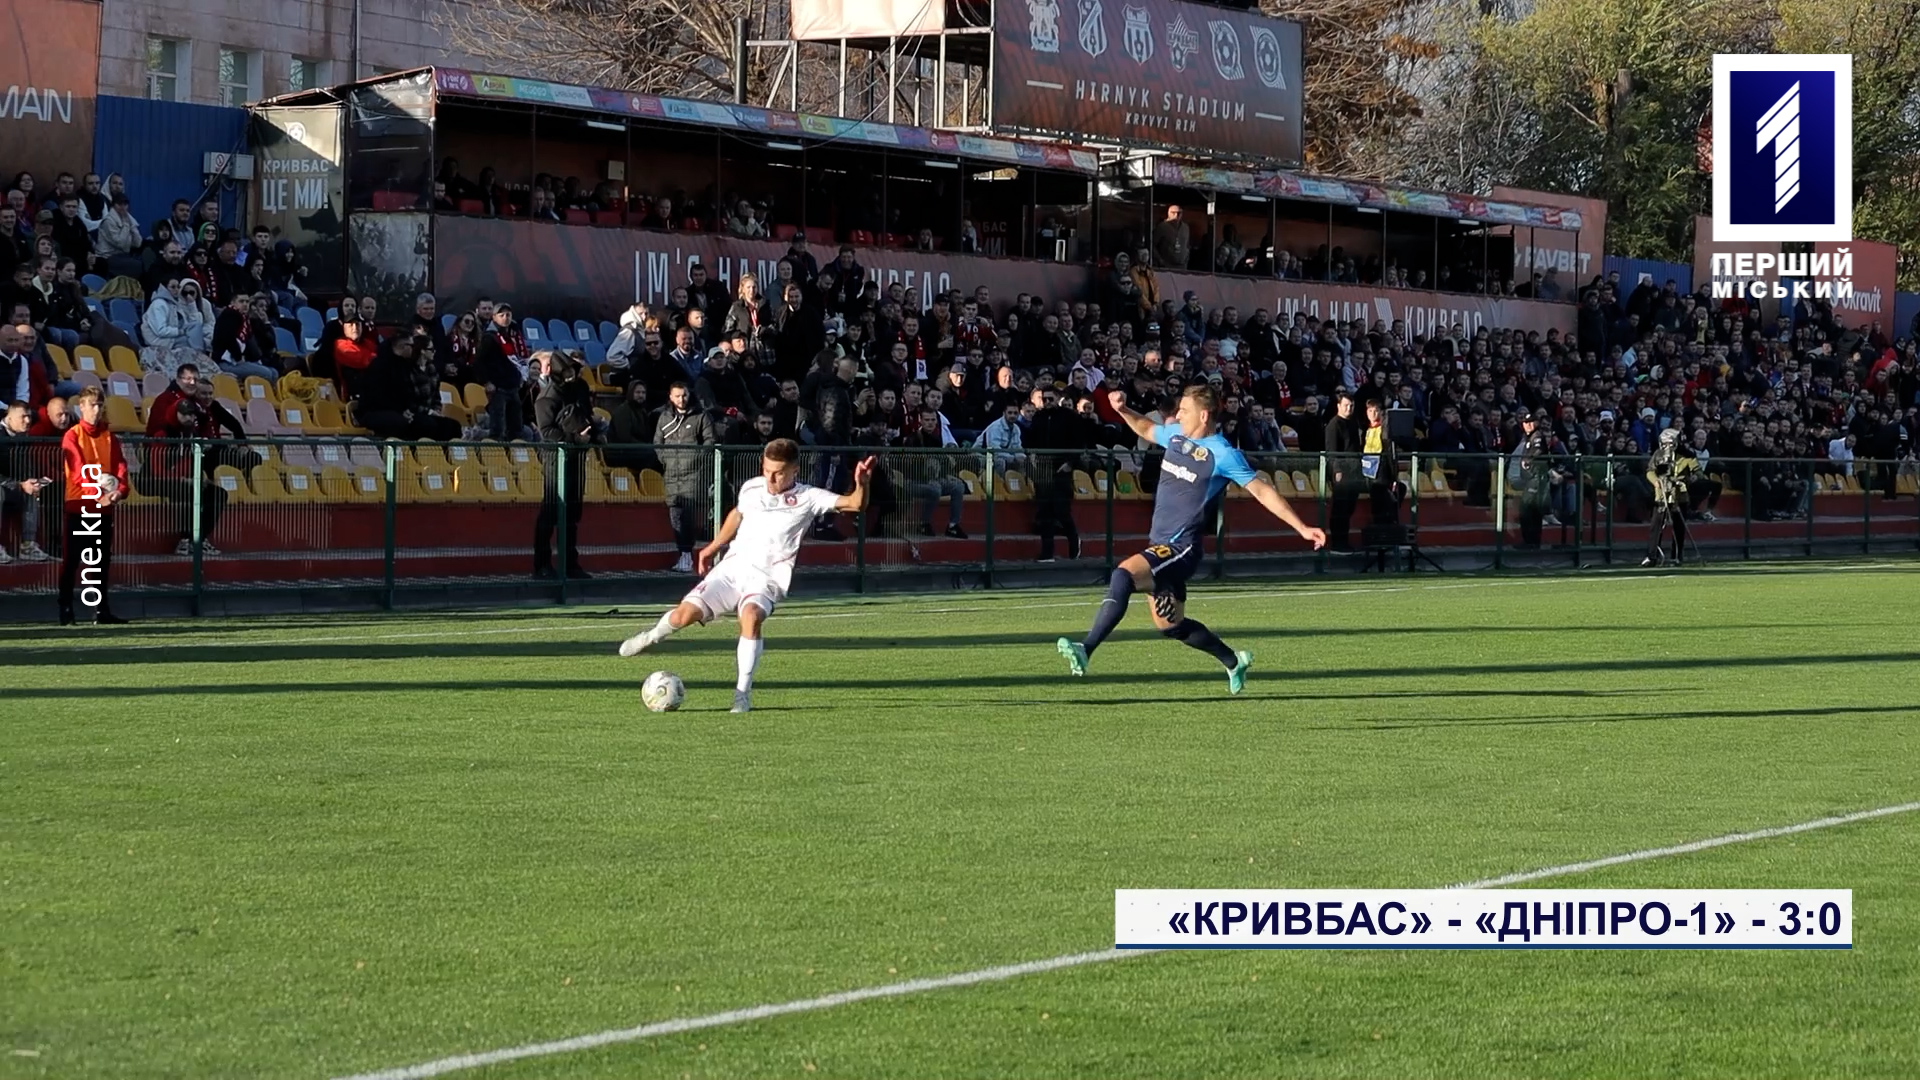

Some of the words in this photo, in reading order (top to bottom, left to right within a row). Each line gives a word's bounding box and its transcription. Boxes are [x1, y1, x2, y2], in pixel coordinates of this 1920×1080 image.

[1075, 80, 1150, 108] HIRNYK
[1163, 92, 1246, 122] STADIUM
[1125, 112, 1169, 129] KRYVYI
[1175, 118, 1197, 133] RIH
[263, 159, 329, 173] КРИВБАС
[262, 178, 288, 215] ЦЕ
[294, 178, 329, 210] МИ!
[1524, 246, 1592, 275] FAVBET
